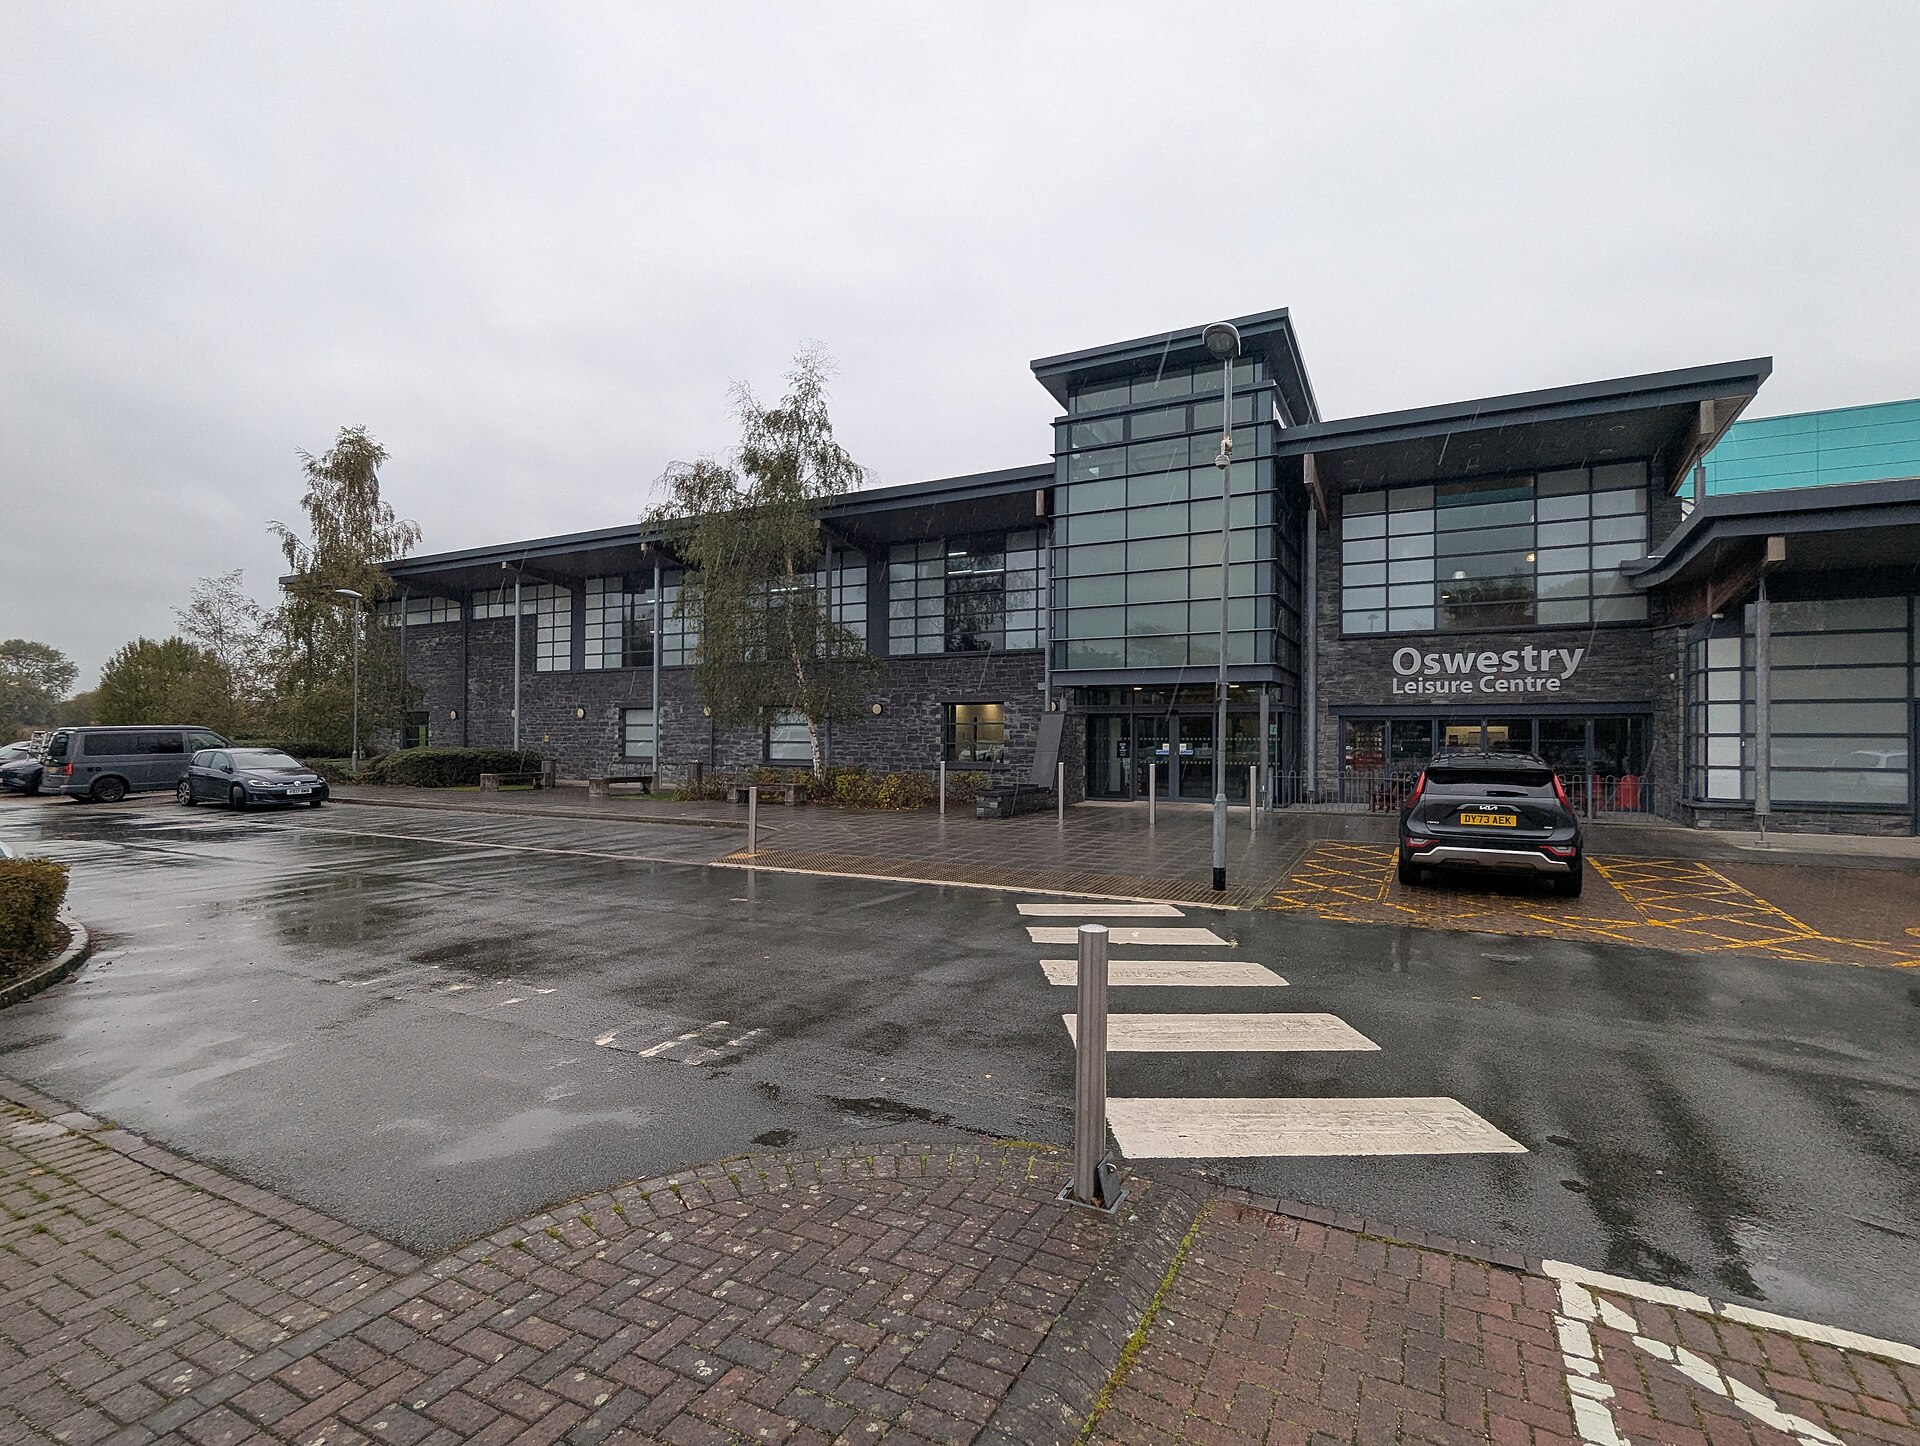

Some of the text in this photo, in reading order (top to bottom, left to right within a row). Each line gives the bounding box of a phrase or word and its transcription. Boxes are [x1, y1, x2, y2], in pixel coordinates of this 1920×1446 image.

[1392, 645, 1584, 680] Oswestry
[1392, 675, 1561, 694] Leisure Centre
[1464, 814, 1512, 825] DY73 AEK
